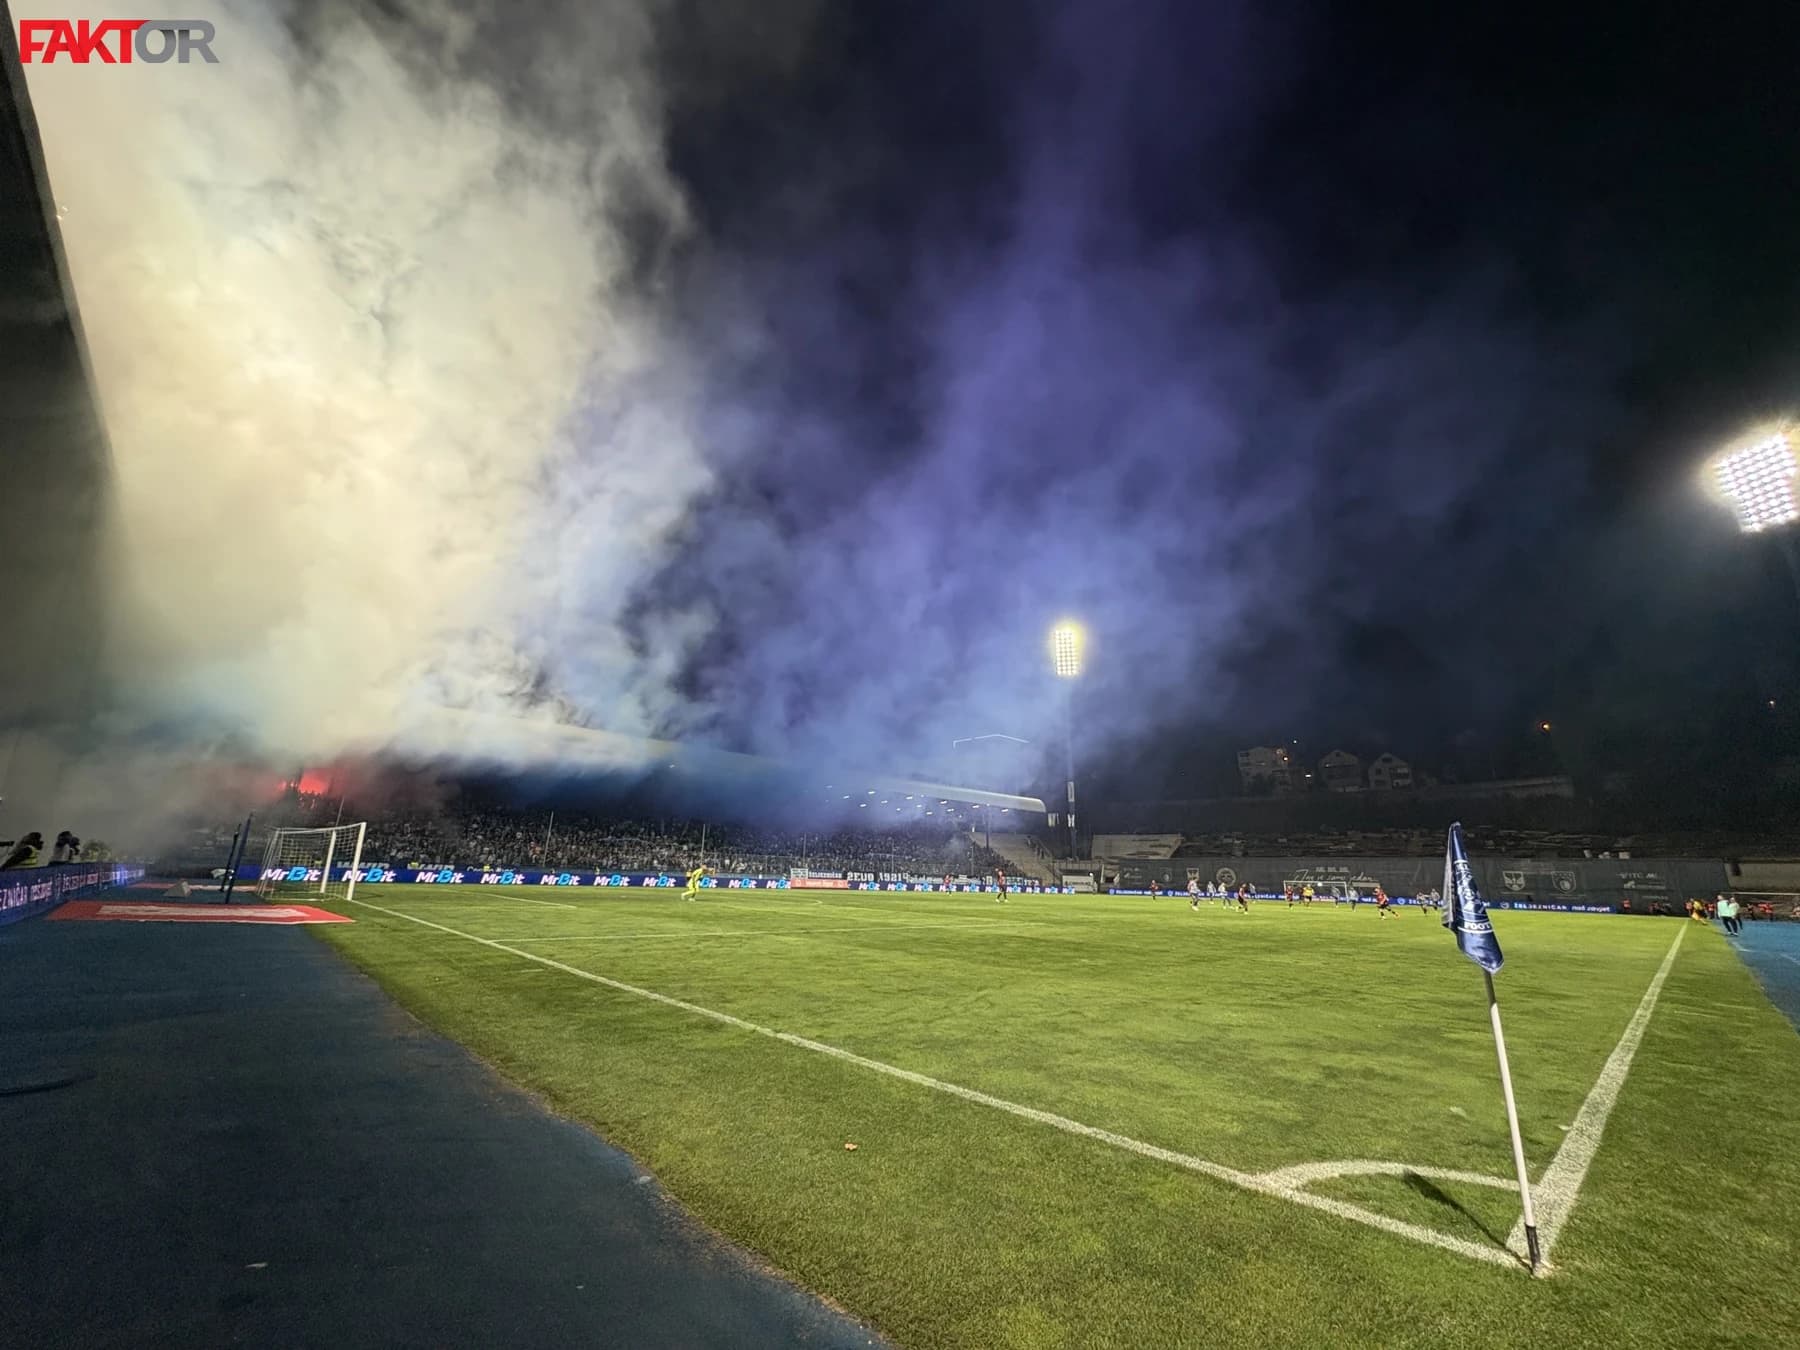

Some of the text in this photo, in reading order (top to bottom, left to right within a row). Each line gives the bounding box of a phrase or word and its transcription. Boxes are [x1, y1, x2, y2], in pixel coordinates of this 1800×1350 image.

[260, 867, 322, 881] MrBit
[341, 868, 397, 883] MrBit
[416, 870, 464, 884] MrBit
[480, 872, 525, 884] MrBit
[540, 873, 580, 887] MrBit
[593, 875, 631, 887] MrBit
[642, 876, 677, 887] MrBit
[728, 878, 757, 888] MrBit
